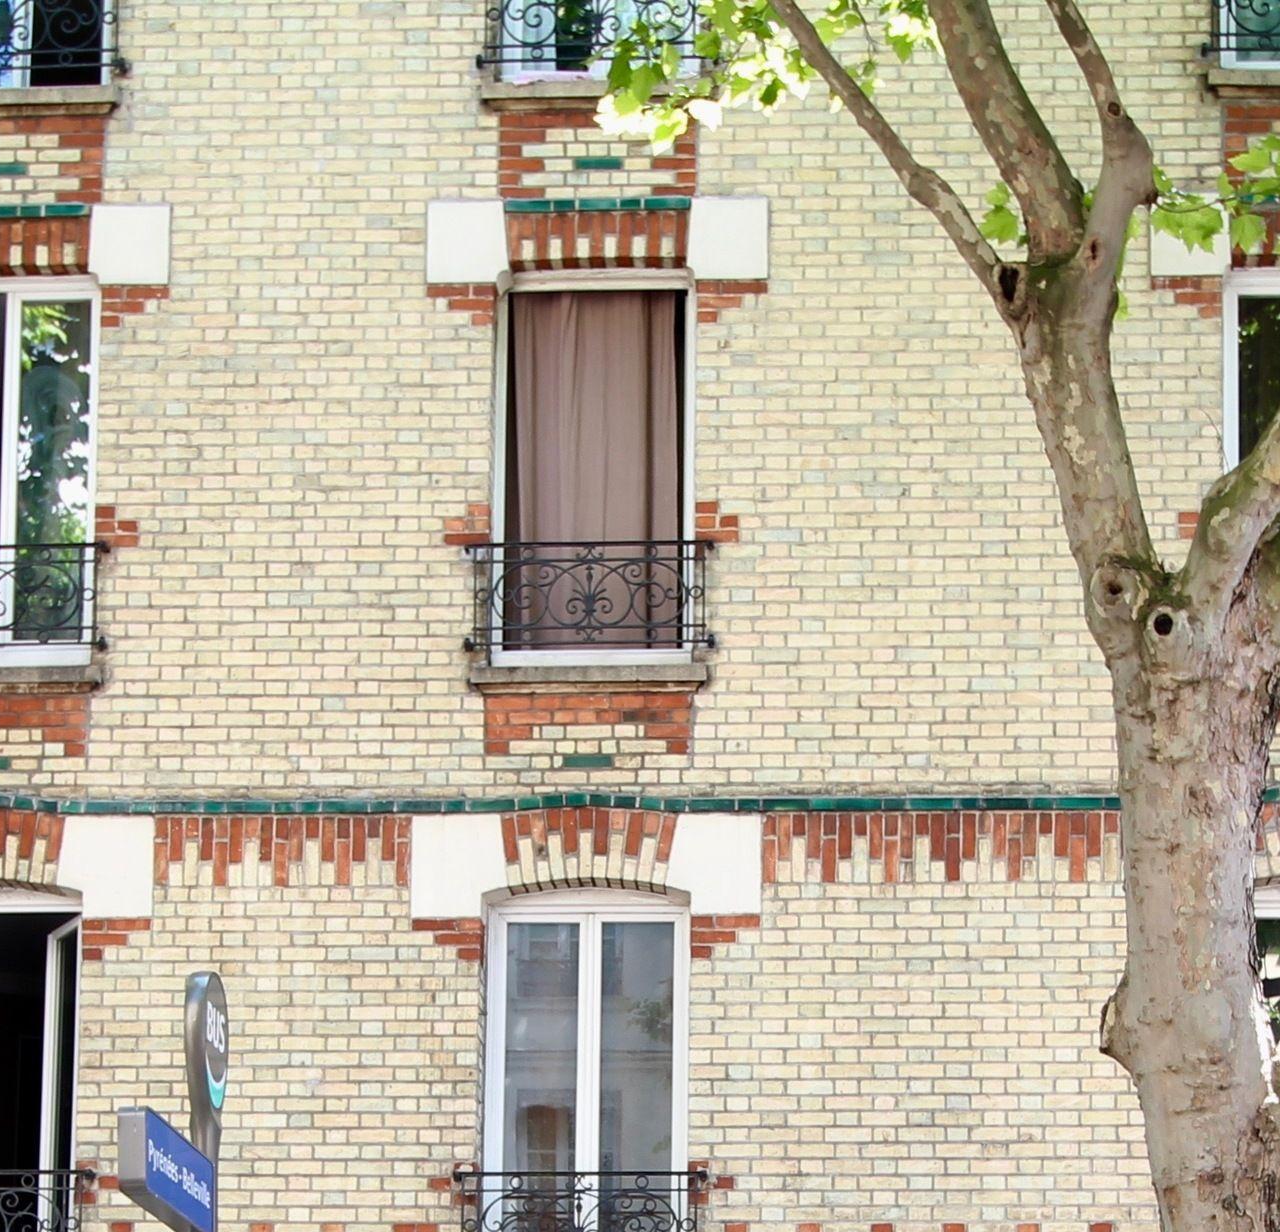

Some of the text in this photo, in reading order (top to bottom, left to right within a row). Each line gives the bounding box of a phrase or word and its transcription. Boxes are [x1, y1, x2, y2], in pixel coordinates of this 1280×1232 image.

[206, 1001, 226, 1053] BUS
[148, 1139, 179, 1184] Pyrénées
[182, 1167, 211, 1209] Belleville
